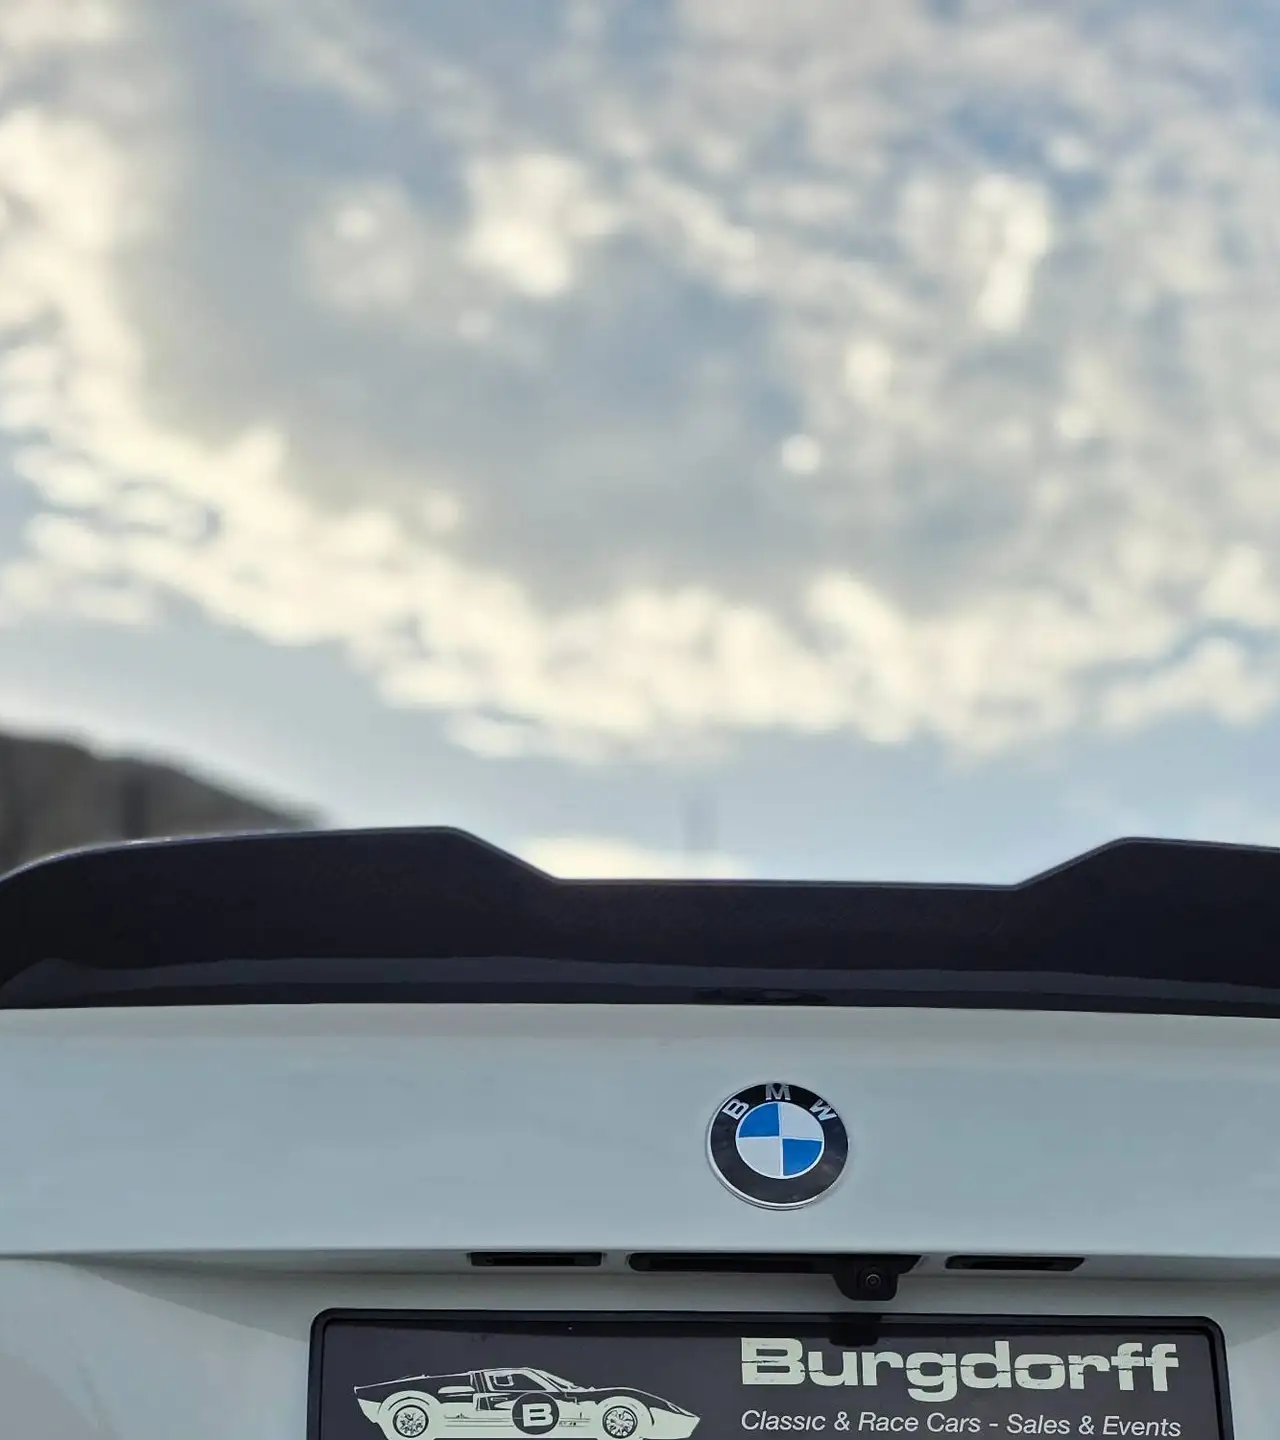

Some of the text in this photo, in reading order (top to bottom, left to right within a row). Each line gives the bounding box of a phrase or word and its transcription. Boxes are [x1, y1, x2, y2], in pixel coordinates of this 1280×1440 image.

[722, 1083, 837, 1121] BMW
[740, 1337, 1180, 1403] Burgdorff
[522, 1403, 554, 1428] B
[741, 1409, 826, 1431] Classic
[833, 1410, 851, 1431] &
[858, 1411, 919, 1432] Race
[926, 1412, 982, 1433] Cars
[1006, 1413, 1071, 1435] Sales
[1078, 1415, 1095, 1435] &
[1102, 1415, 1182, 1437] Events
